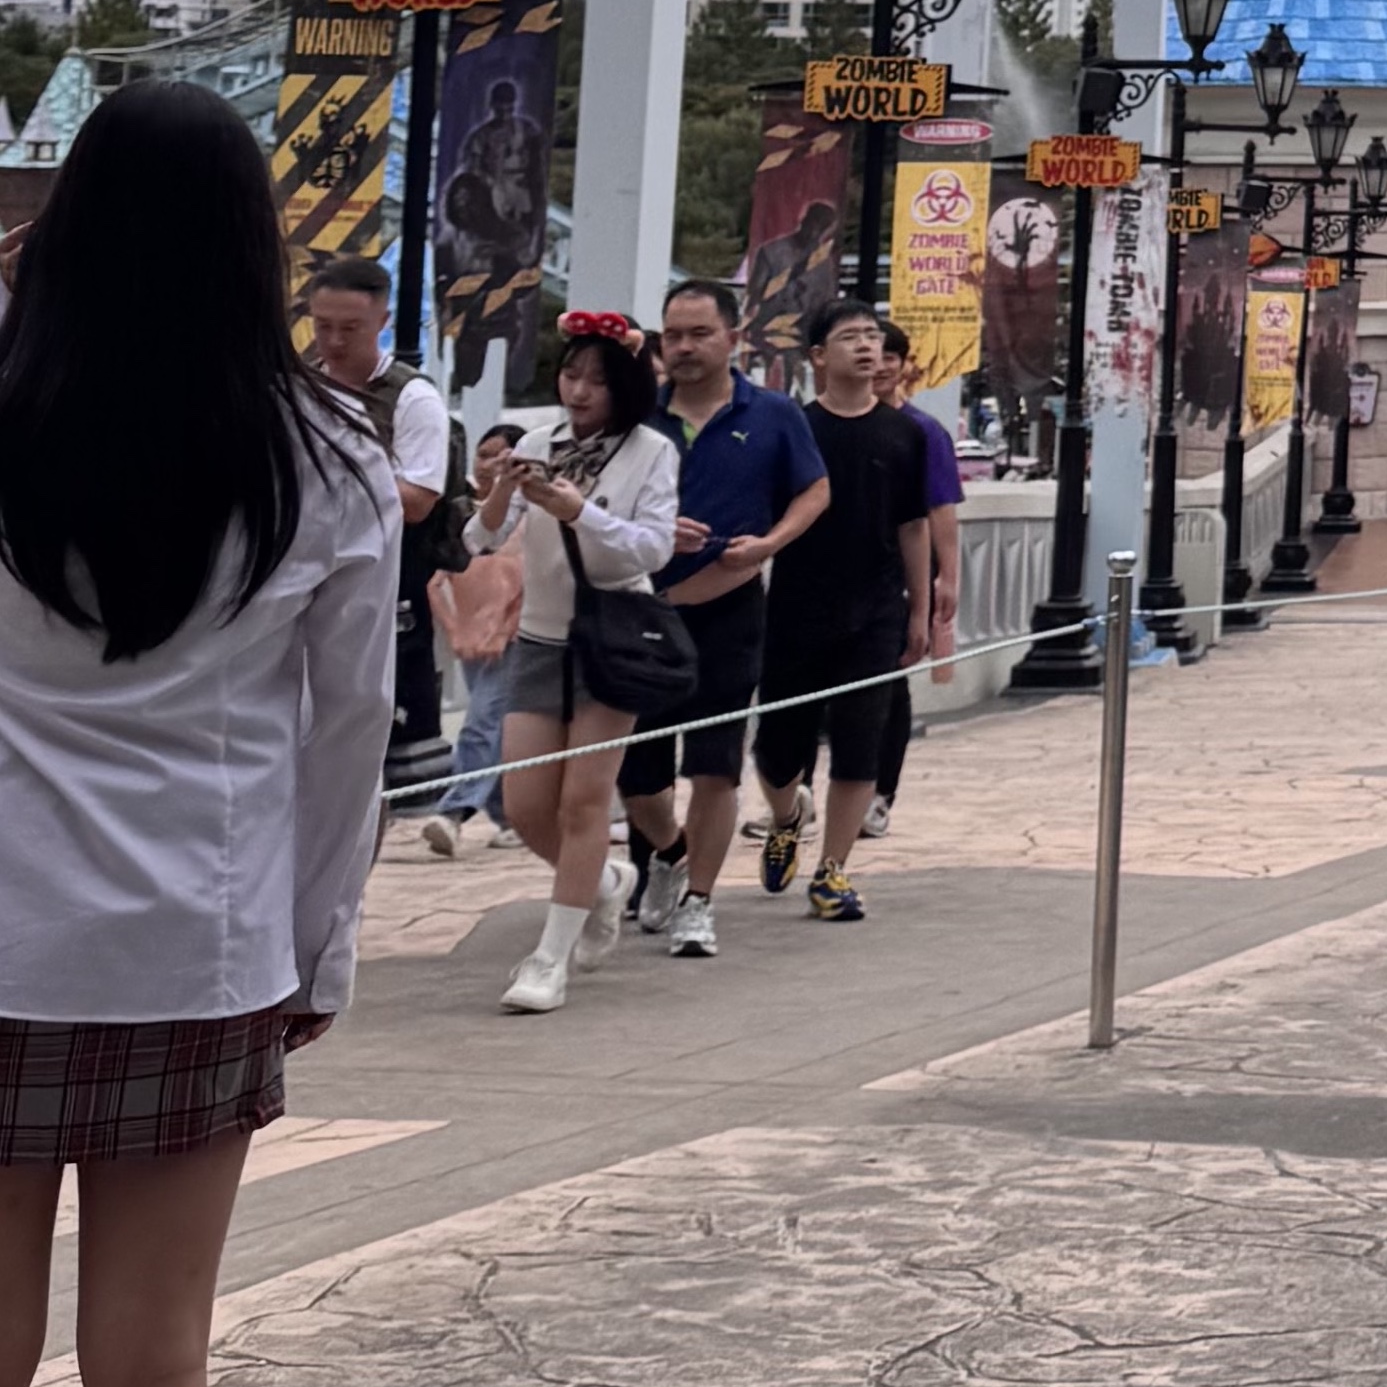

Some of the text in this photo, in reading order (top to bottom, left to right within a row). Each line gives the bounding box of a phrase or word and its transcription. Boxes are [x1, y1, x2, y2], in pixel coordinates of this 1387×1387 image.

[295, 18, 394, 57] WARNING
[835, 57, 918, 83] ZOMBIE
[823, 84, 928, 117] WORLD
[1051, 136, 1121, 157] ZOMBIE
[1041, 159, 1126, 185] WORLD
[1169, 188, 1203, 206] MBIE
[1113, 187, 1143, 264] ZOMBIE
[1168, 208, 1210, 229] RLD
[909, 233, 968, 249] ZOMBIE
[908, 254, 969, 272] WORLD
[916, 277, 954, 295] GATE
